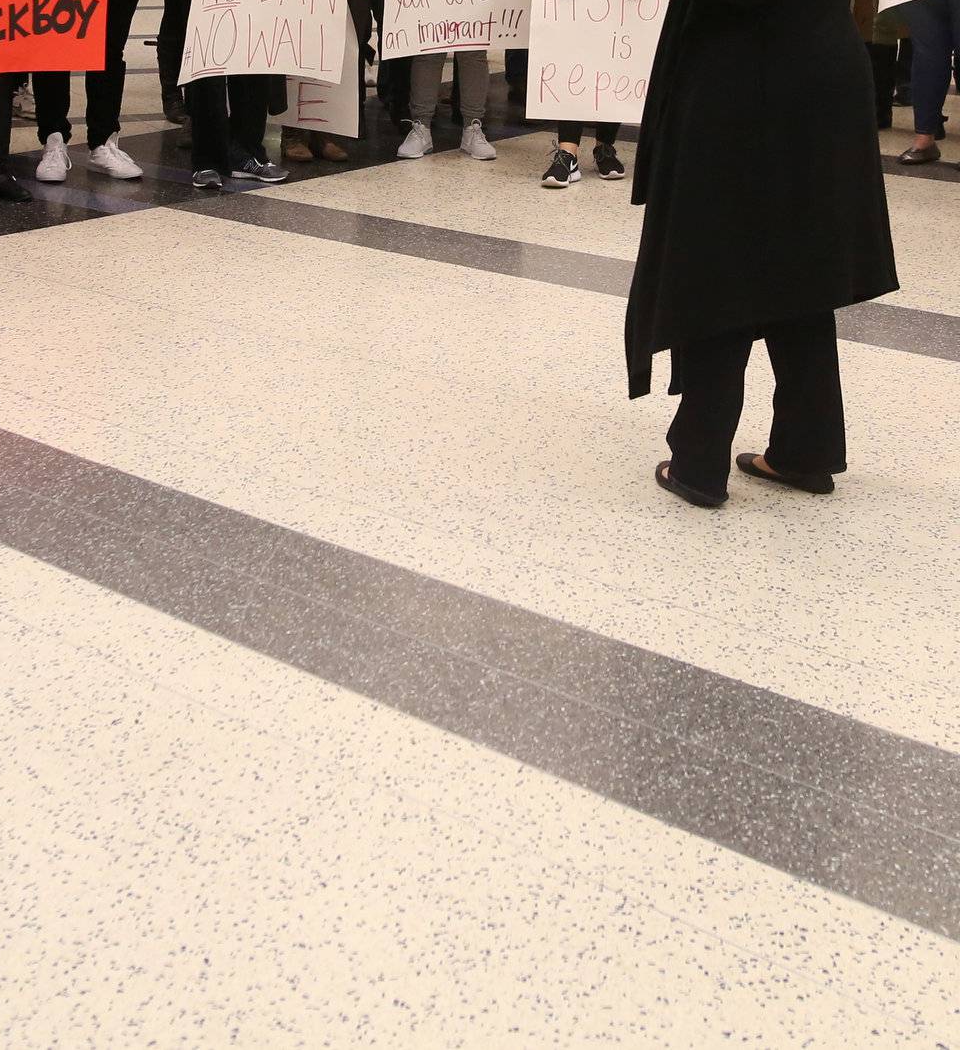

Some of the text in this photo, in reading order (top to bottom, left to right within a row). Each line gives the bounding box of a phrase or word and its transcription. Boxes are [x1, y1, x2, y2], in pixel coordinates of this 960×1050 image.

[247, 12, 333, 72] WALL
[385, 28, 409, 50] an
[611, 31, 632, 60] is
